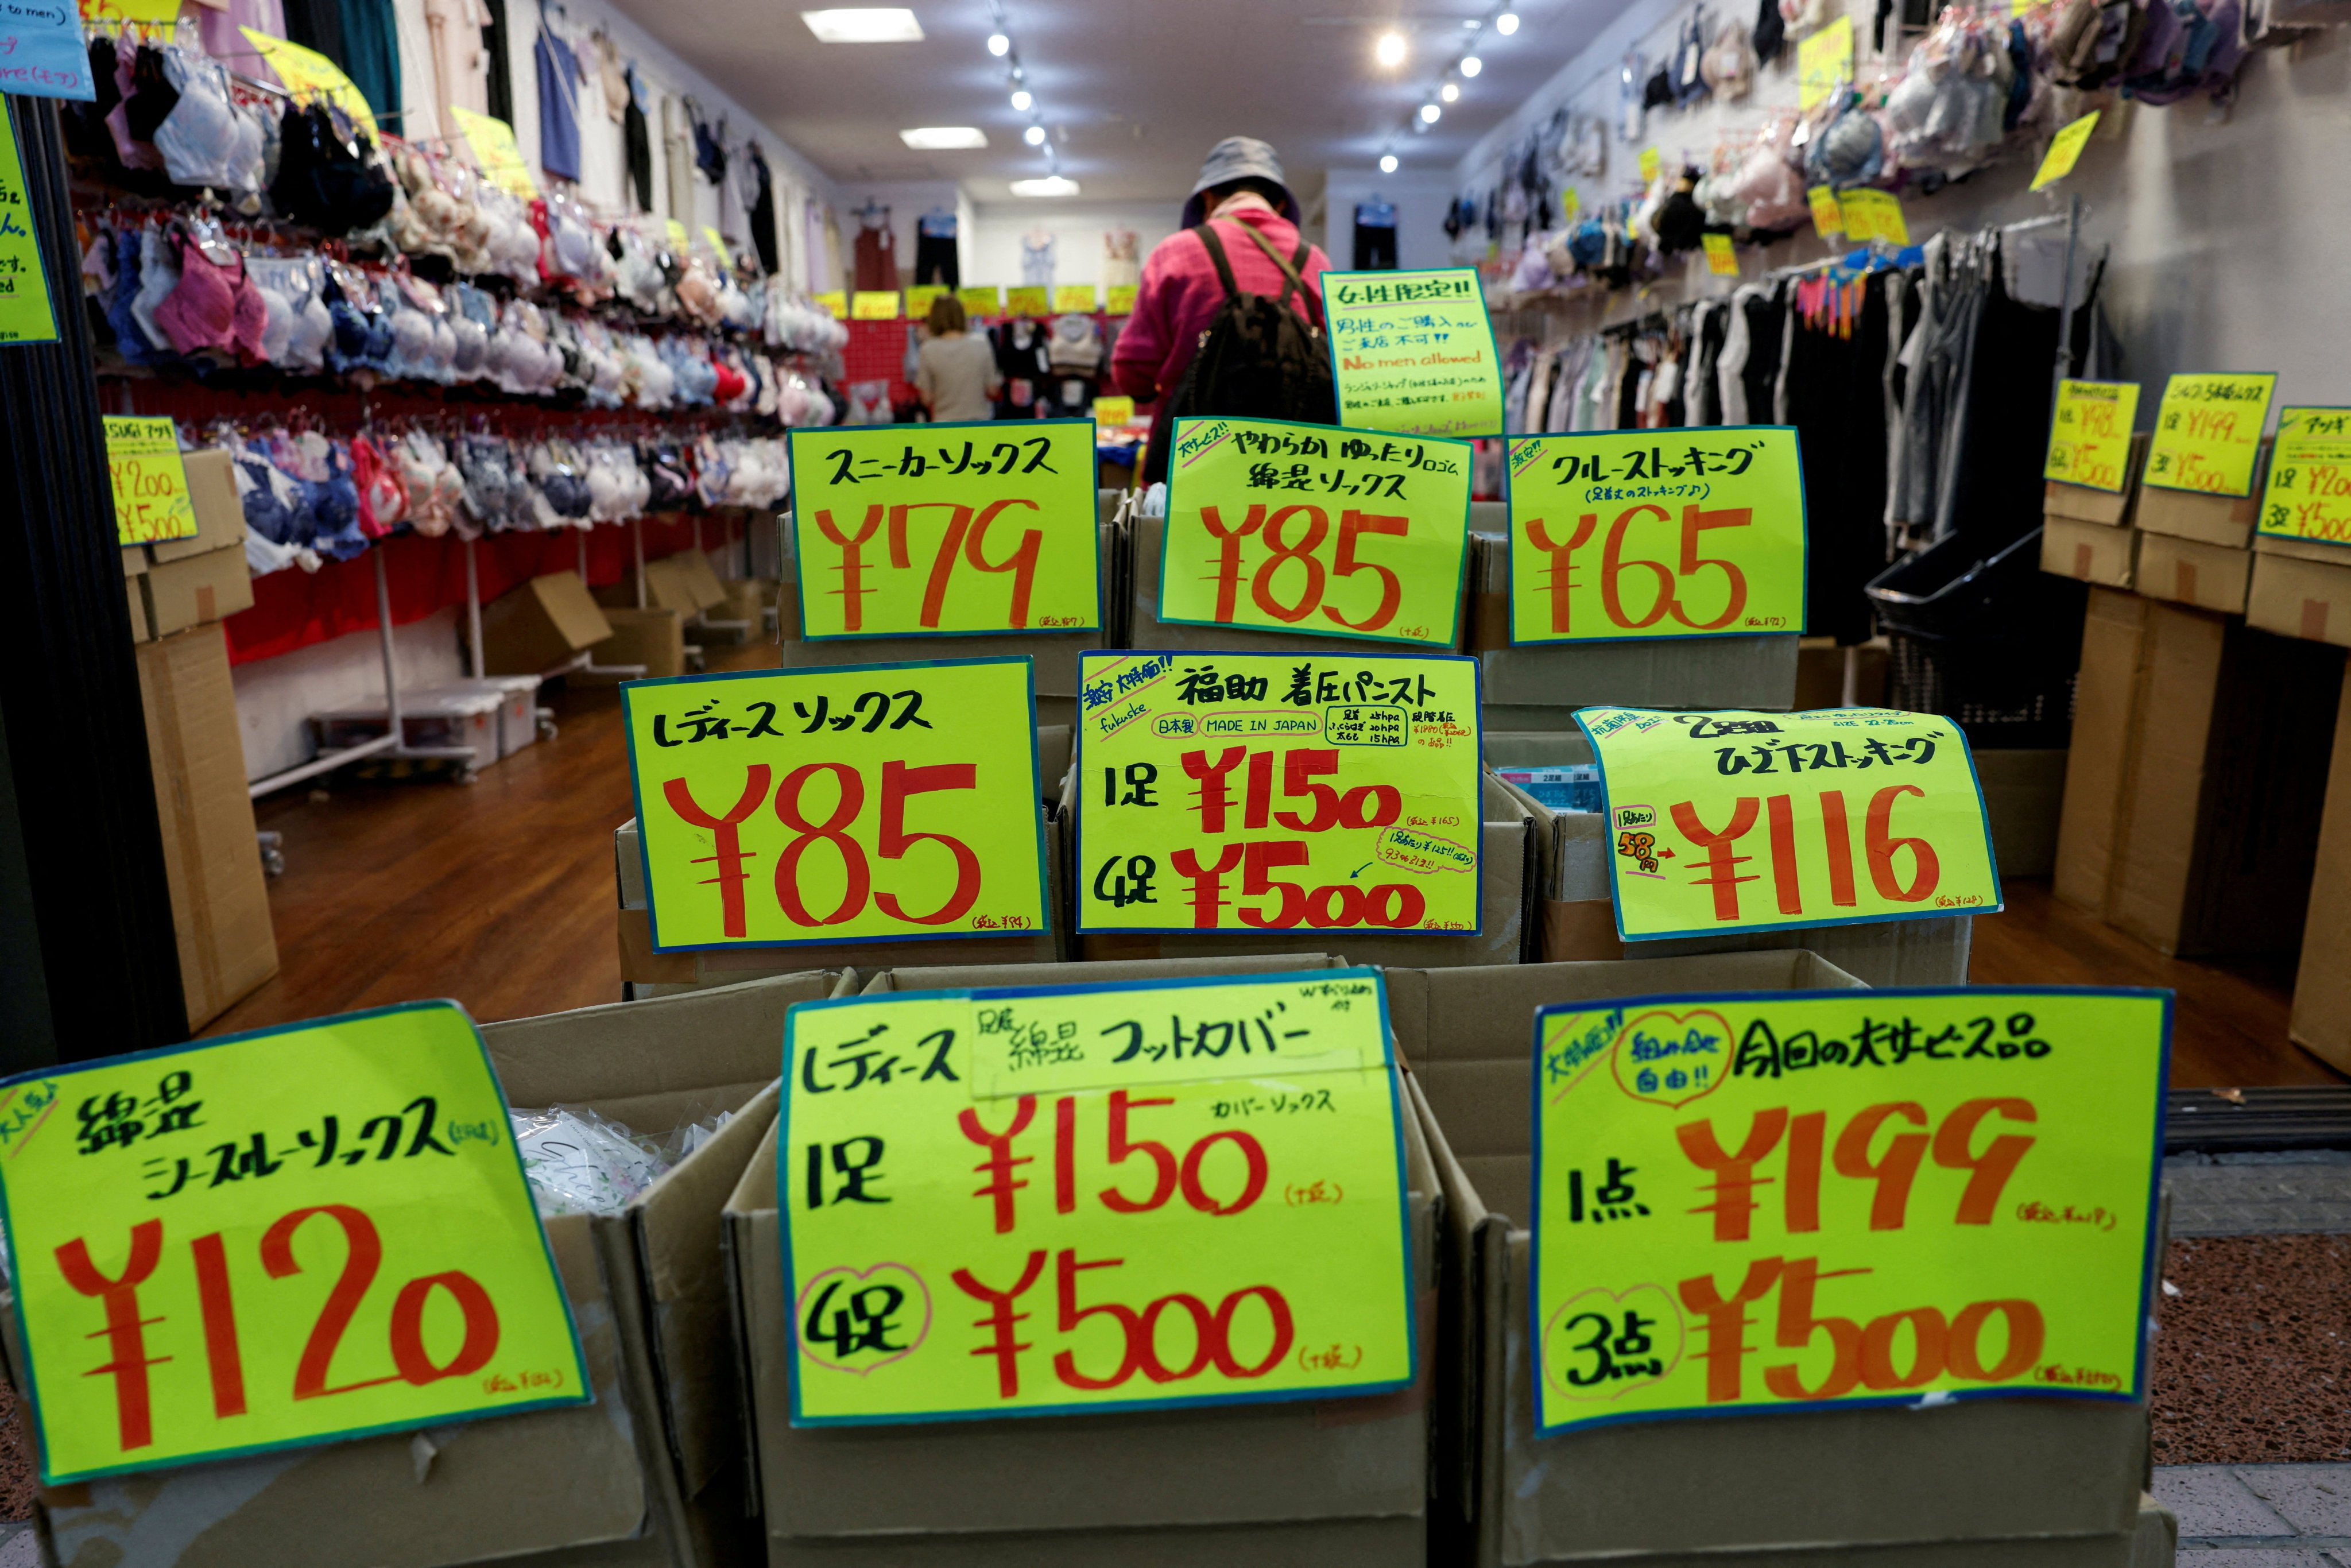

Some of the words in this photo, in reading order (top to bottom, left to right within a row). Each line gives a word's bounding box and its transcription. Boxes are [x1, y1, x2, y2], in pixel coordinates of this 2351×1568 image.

[1337, 280, 1471, 304] 女性限定!!
[1343, 355, 1374, 371] No
[1378, 357, 1416, 367] men
[1421, 350, 1481, 366] allowed
[1178, 421, 1230, 458] 大サービス!!
[1231, 430, 1329, 459] やわらか
[2187, 408, 2238, 442] ¥199
[825, 437, 1059, 485] スニーカーソックス
[1512, 440, 1541, 469] 激安!!
[1552, 440, 1766, 485] クルーストッキング
[2175, 451, 2225, 493] ¥500
[109, 460, 172, 500] ¥200
[118, 503, 183, 543] ¥500
[814, 499, 1043, 632] ¥79
[1198, 504, 1409, 632] ¥85
[1525, 504, 1753, 633] ¥65
[1175, 665, 1269, 705] 福助
[1280, 663, 1436, 707] 着圧パンスト
[653, 699, 785, 748] レディース
[793, 689, 934, 734] ソックス
[1099, 702, 1147, 734] fukuske
[1159, 718, 1195, 734] 日本製
[1206, 719, 1244, 733] MADE
[1250, 719, 1266, 731] IN
[1272, 718, 1317, 732] JAPAN
[1329, 721, 1366, 732] ふくらはぎ
[1369, 723, 1400, 733] 20hpa
[1342, 708, 1361, 721] 足首
[1864, 718, 1915, 727] 22-25cm
[1369, 734, 1400, 745] 15hpa
[1714, 730, 1945, 776] ひざ下ストッキング
[1103, 761, 1160, 808] 1足
[1180, 744, 1403, 834] ¥150
[1543, 774, 1562, 782] 2足組
[1617, 810, 1653, 827] 1足あたり
[663, 759, 982, 939] ¥85
[1669, 784, 1941, 921] ¥116
[1093, 854, 1159, 908] 4足
[1170, 839, 1427, 928] ¥500
[971, 914, 1032, 930] (税込¥94)
[801, 1023, 962, 1095] レディース
[1101, 1000, 1312, 1064] フットカバー
[1732, 1012, 2052, 1079] 今回の大サービス品
[1636, 1064, 1711, 1094] 自由!!
[75, 1070, 208, 1156] 綿混
[142, 1096, 456, 1199] シースルーソックス
[956, 1089, 1271, 1236] ¥150
[1675, 1096, 2039, 1243] ¥199
[806, 1135, 894, 1210] 1足
[1568, 1156, 1652, 1224] 1点
[53, 1203, 501, 1453] ¥120
[805, 1279, 911, 1360] 4足
[950, 1247, 1296, 1400] ¥500
[1678, 1255, 2046, 1404] ¥500
[1565, 1310, 1664, 1387] 3点
